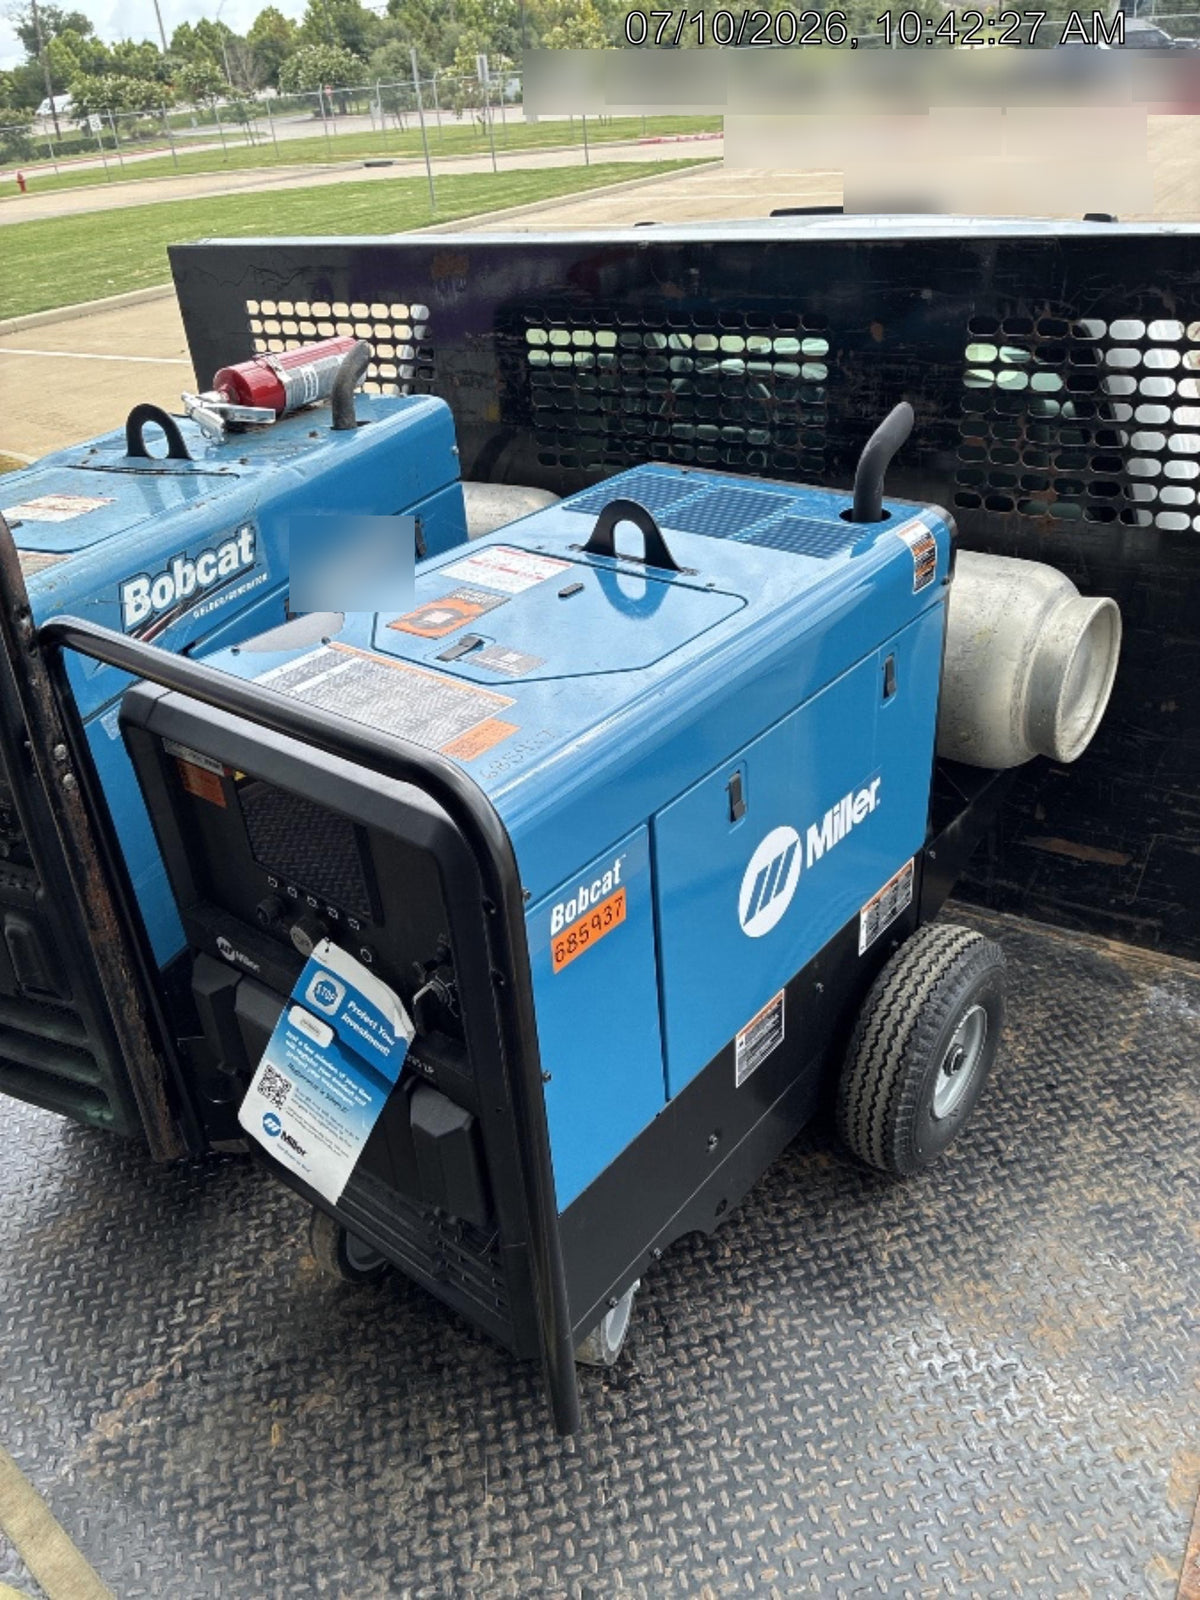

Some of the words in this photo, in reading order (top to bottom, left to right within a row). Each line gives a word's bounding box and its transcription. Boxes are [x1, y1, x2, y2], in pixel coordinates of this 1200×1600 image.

[123, 527, 255, 627] Bobcat
[806, 777, 881, 869] Miller
[550, 857, 623, 936] Bobcat
[554, 896, 623, 963] 685937
[347, 1000, 378, 1030] Protect
[281, 1130, 306, 1156] Miller
